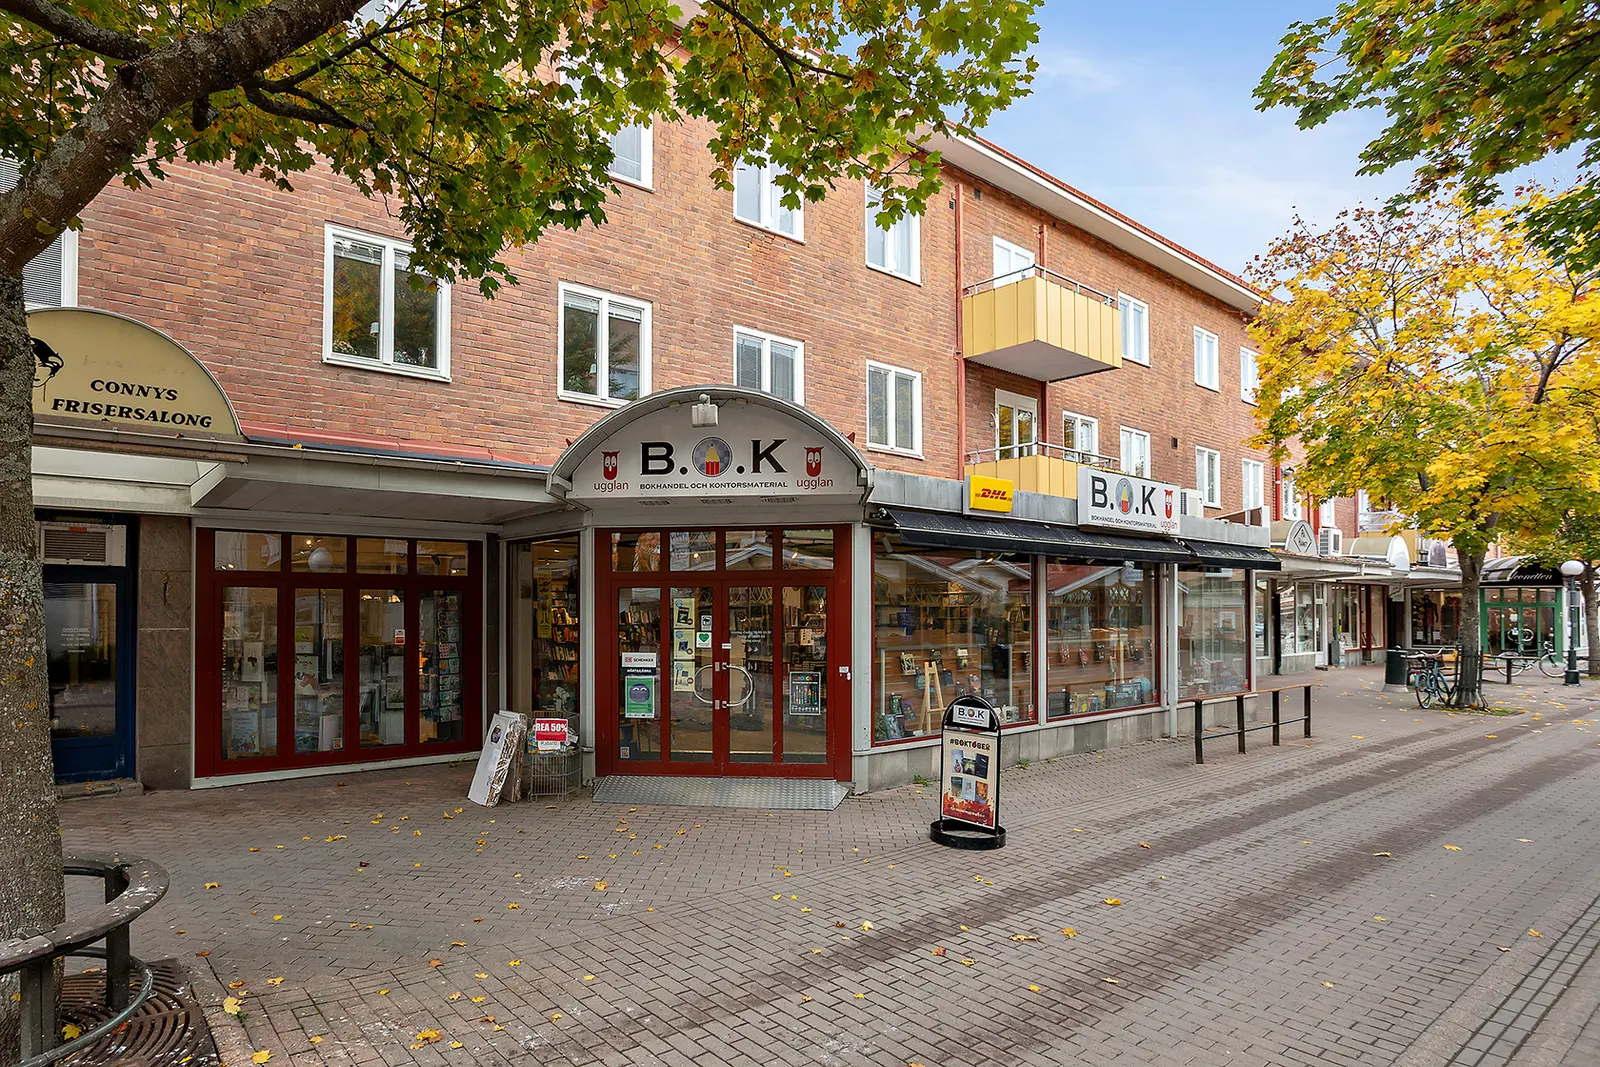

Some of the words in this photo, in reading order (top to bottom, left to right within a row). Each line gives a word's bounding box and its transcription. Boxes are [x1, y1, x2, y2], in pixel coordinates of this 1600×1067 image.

[90, 379, 178, 401] CONNYS
[51, 398, 212, 428] FRISERSALONG
[593, 480, 629, 493] ugglan
[690, 482, 708, 490] OCH
[709, 481, 788, 489] KONTORSMATERIAL
[796, 476, 834, 490] ugglan
[981, 488, 1007, 501] DHL
[1091, 515, 1115, 524] BOKHANDEL
[1160, 520, 1178, 531] ugglan
[536, 723, 550, 732] REA
[551, 723, 568, 733] 50%
